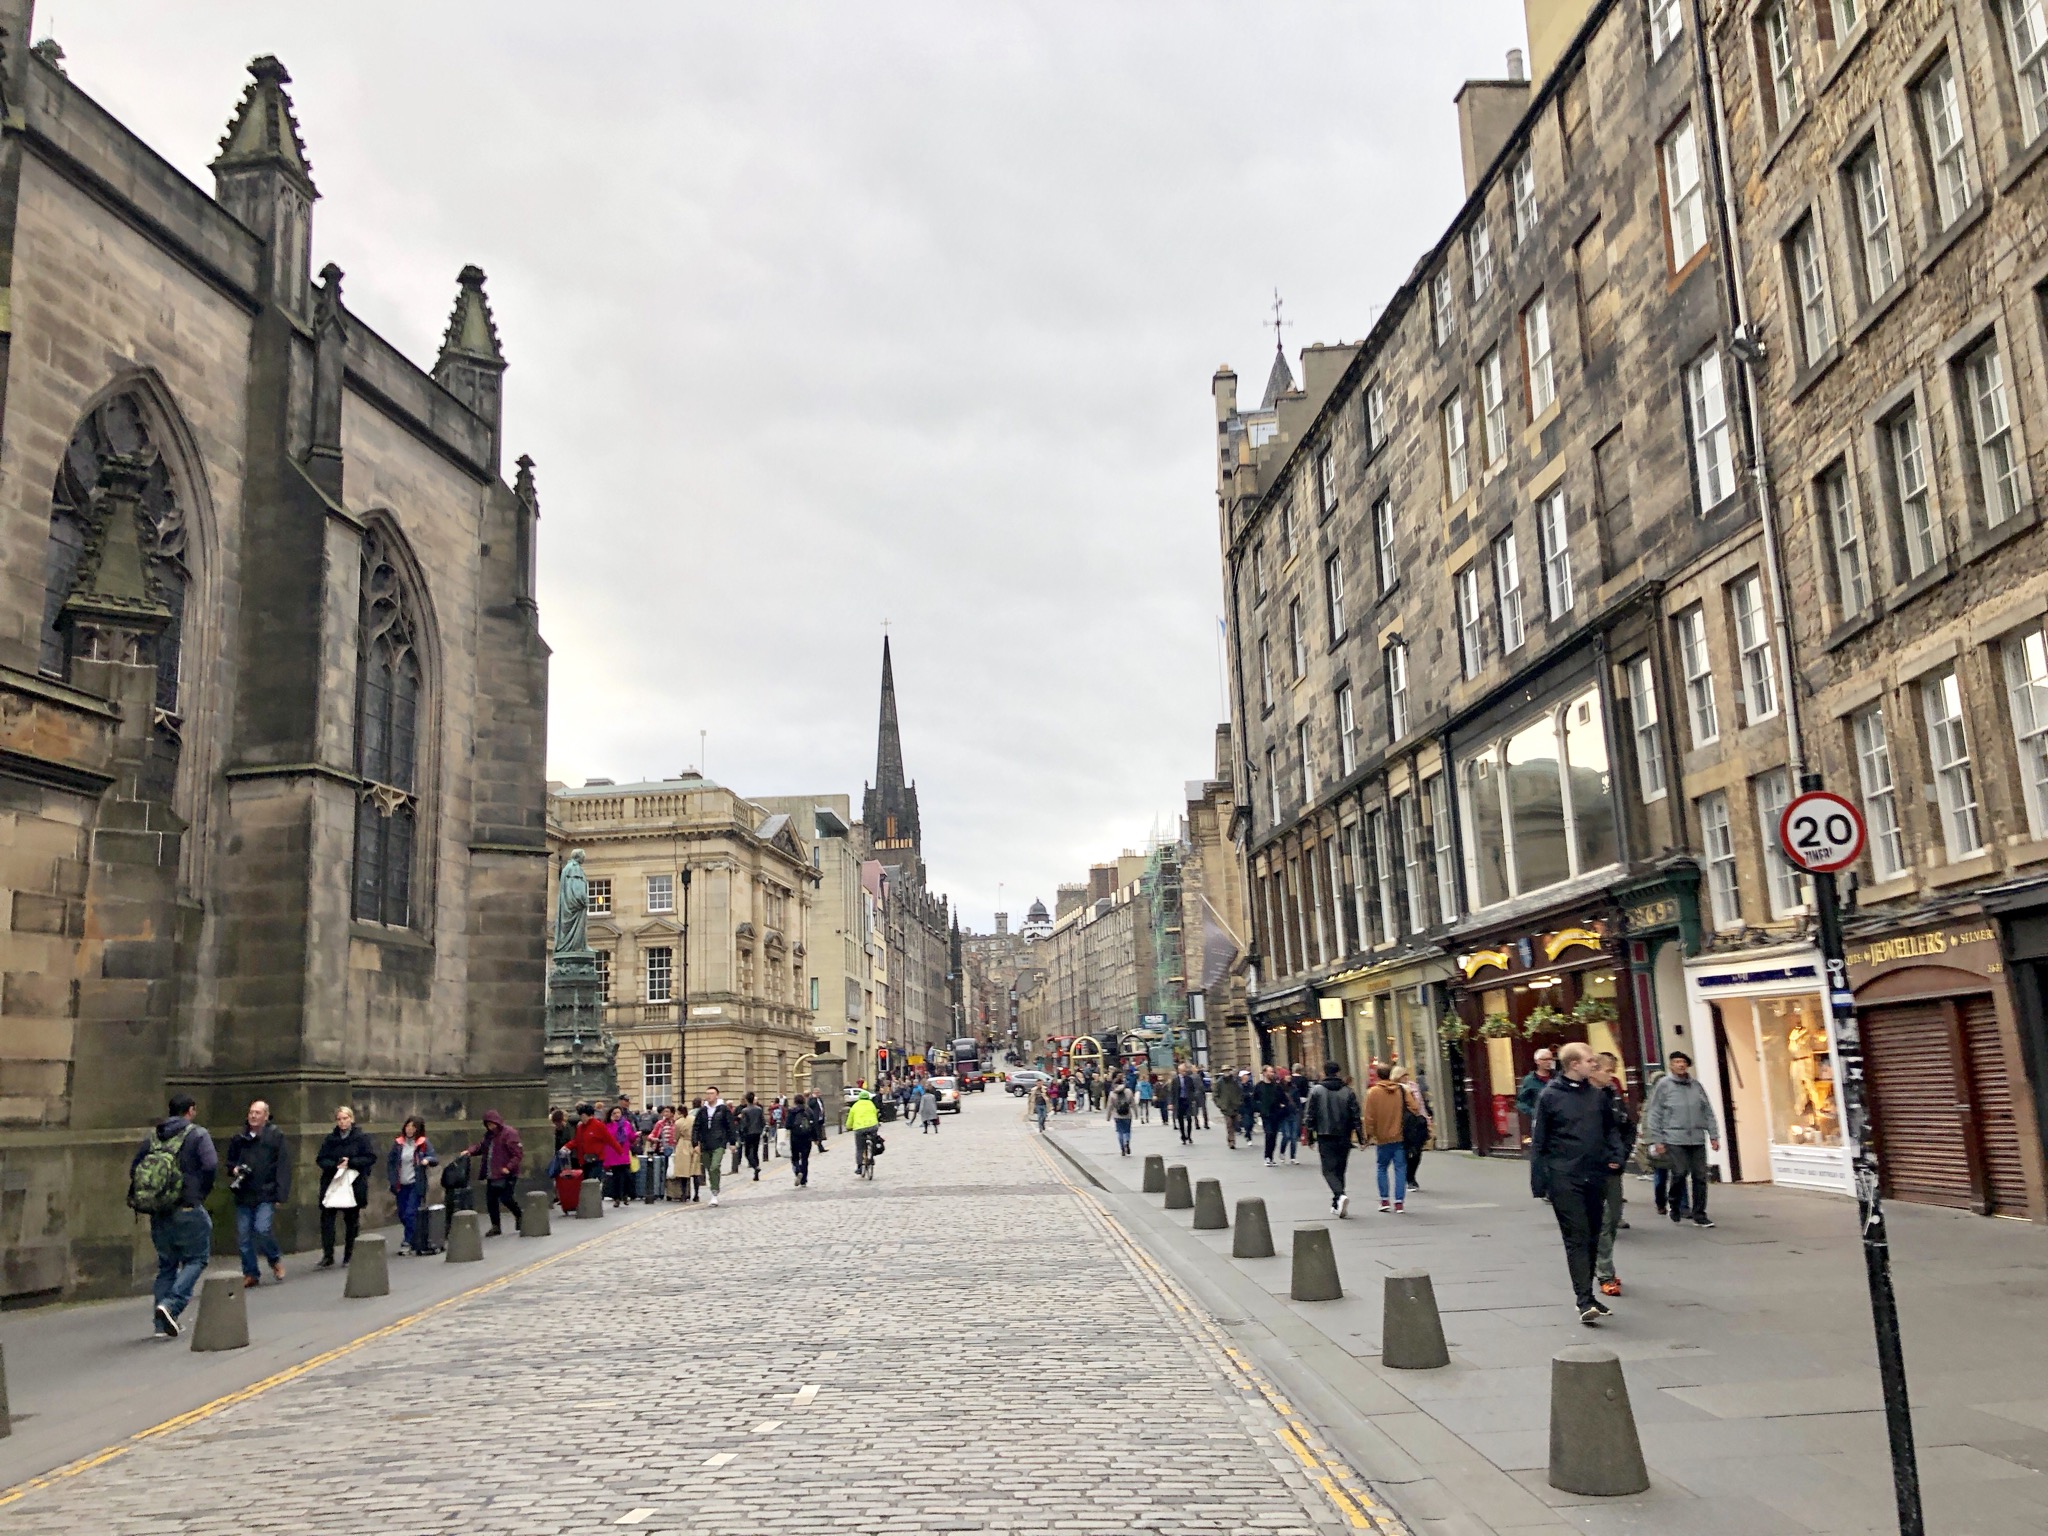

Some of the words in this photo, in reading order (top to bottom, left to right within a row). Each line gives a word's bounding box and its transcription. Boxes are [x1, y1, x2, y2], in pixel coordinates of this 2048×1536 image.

[1794, 813, 1852, 848] 20
[1869, 931, 1947, 966] JEWELLERS
[1960, 929, 1996, 944] SILVER
